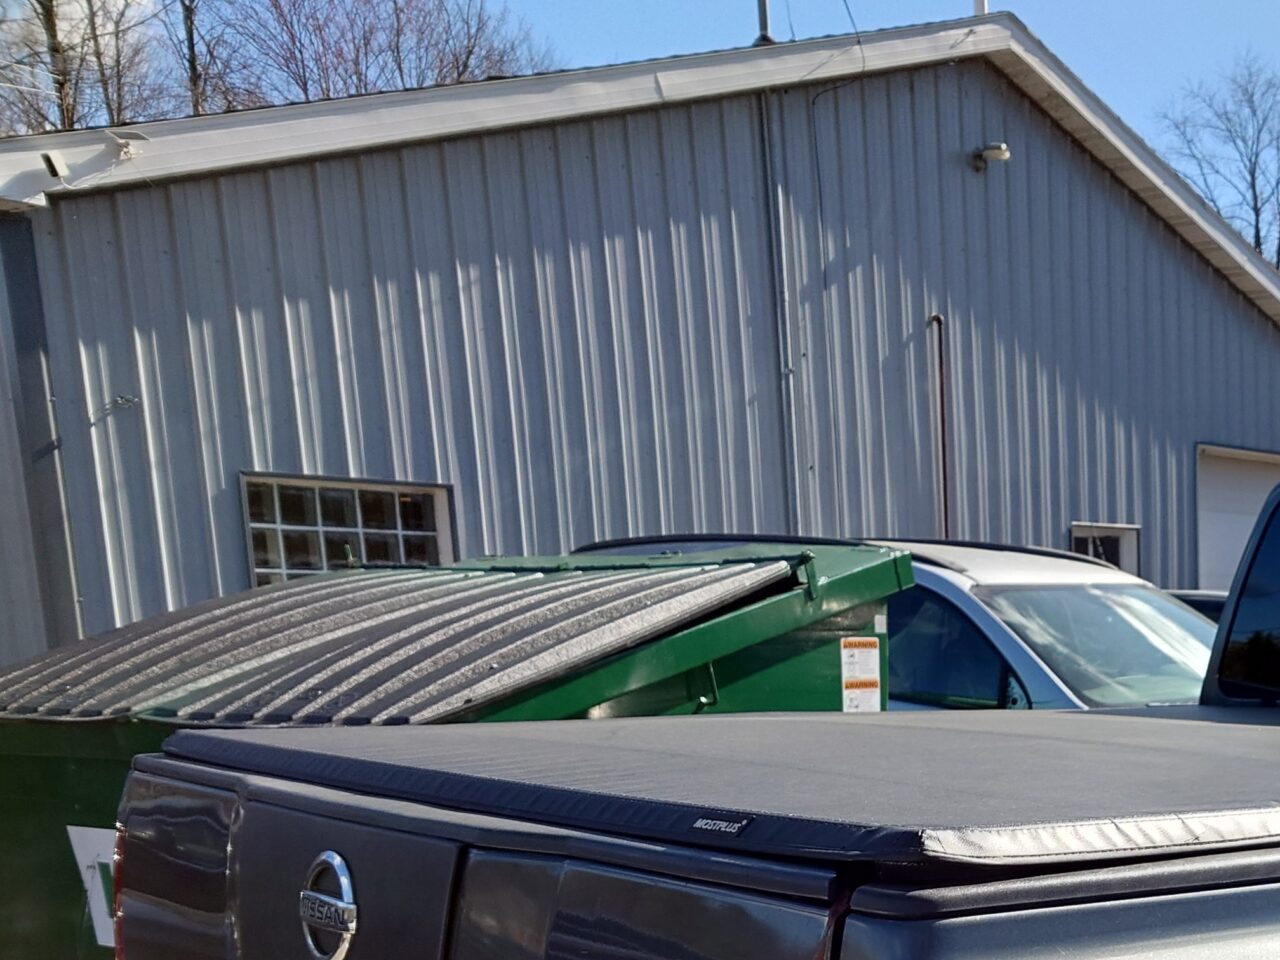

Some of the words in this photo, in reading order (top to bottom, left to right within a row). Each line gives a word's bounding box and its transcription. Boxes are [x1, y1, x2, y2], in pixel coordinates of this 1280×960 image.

[847, 641, 878, 649] WARNING
[850, 681, 879, 689] WARNING
[692, 818, 742, 833] MOSTPLUS
[300, 894, 346, 926] NISSAN
